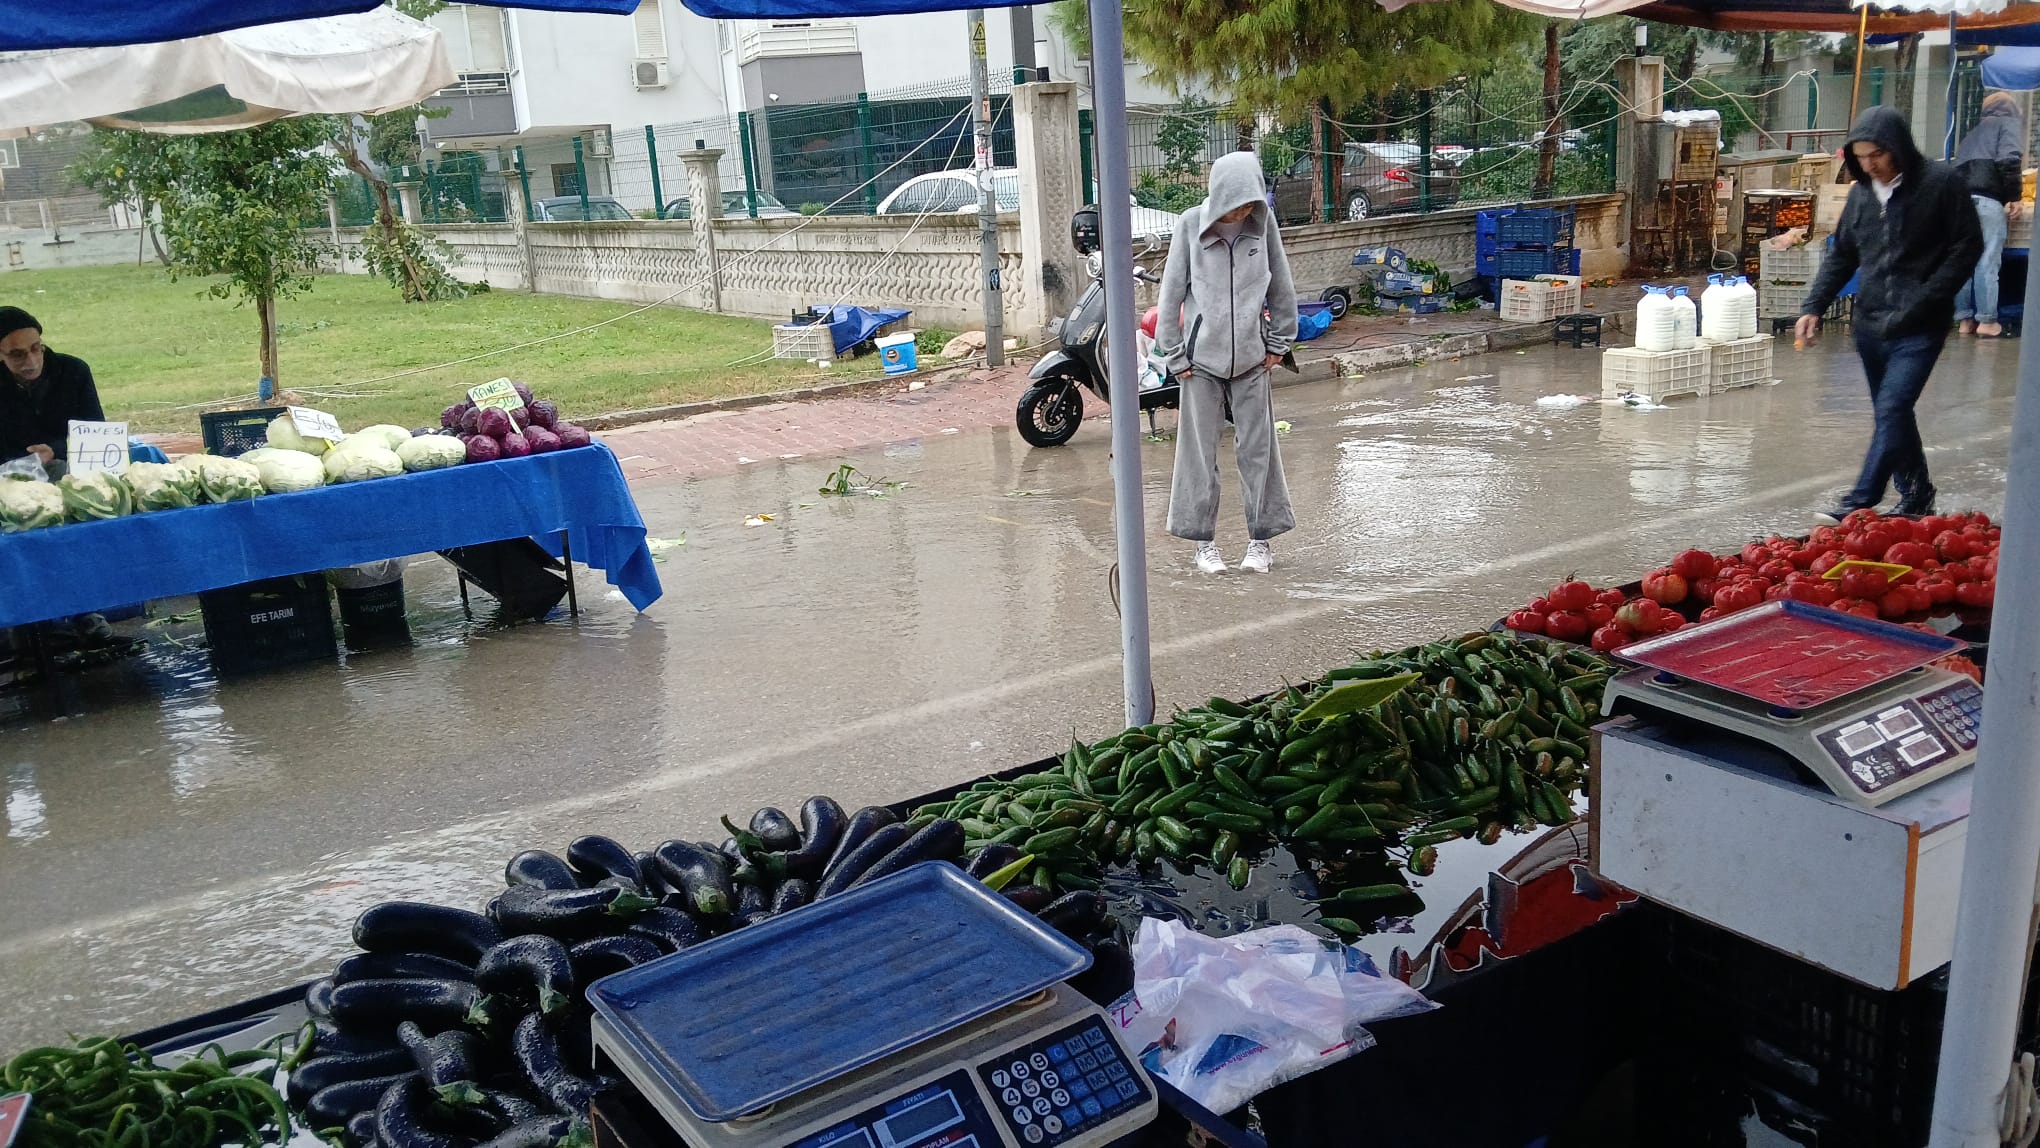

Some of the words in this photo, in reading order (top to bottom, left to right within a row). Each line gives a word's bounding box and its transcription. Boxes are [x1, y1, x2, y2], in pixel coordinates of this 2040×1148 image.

[77, 441, 122, 471] 40
[250, 612, 268, 624] EFE
[994, 1070, 1009, 1086] 7
[1015, 1063, 1026, 1077] 8
[1032, 1054, 1044, 1069] 9
[1006, 1089, 1018, 1104] 4
[1025, 1081, 1037, 1096] 5
[1044, 1072, 1057, 1087] 6
[1017, 1107, 1029, 1121] 1
[1036, 1098, 1050, 1114] 2
[1054, 1089, 1068, 1105] 3
